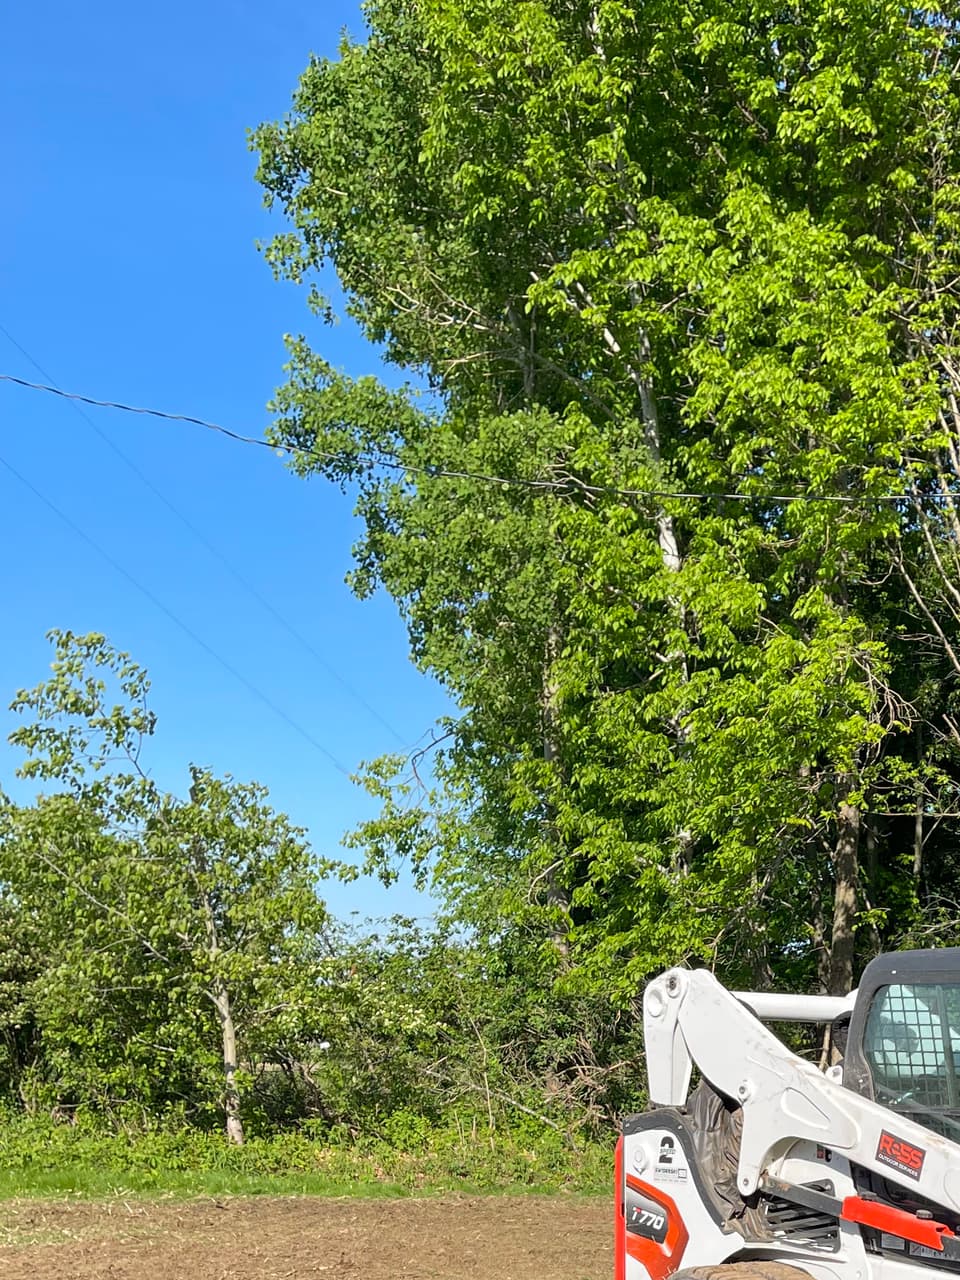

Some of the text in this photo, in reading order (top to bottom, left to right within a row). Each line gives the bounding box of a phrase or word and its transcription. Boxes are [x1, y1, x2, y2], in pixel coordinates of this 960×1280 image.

[881, 1134, 922, 1169] ROSS
[878, 1153, 918, 1177] OUTDOOR SERVICES
[632, 1206, 665, 1230] T770
